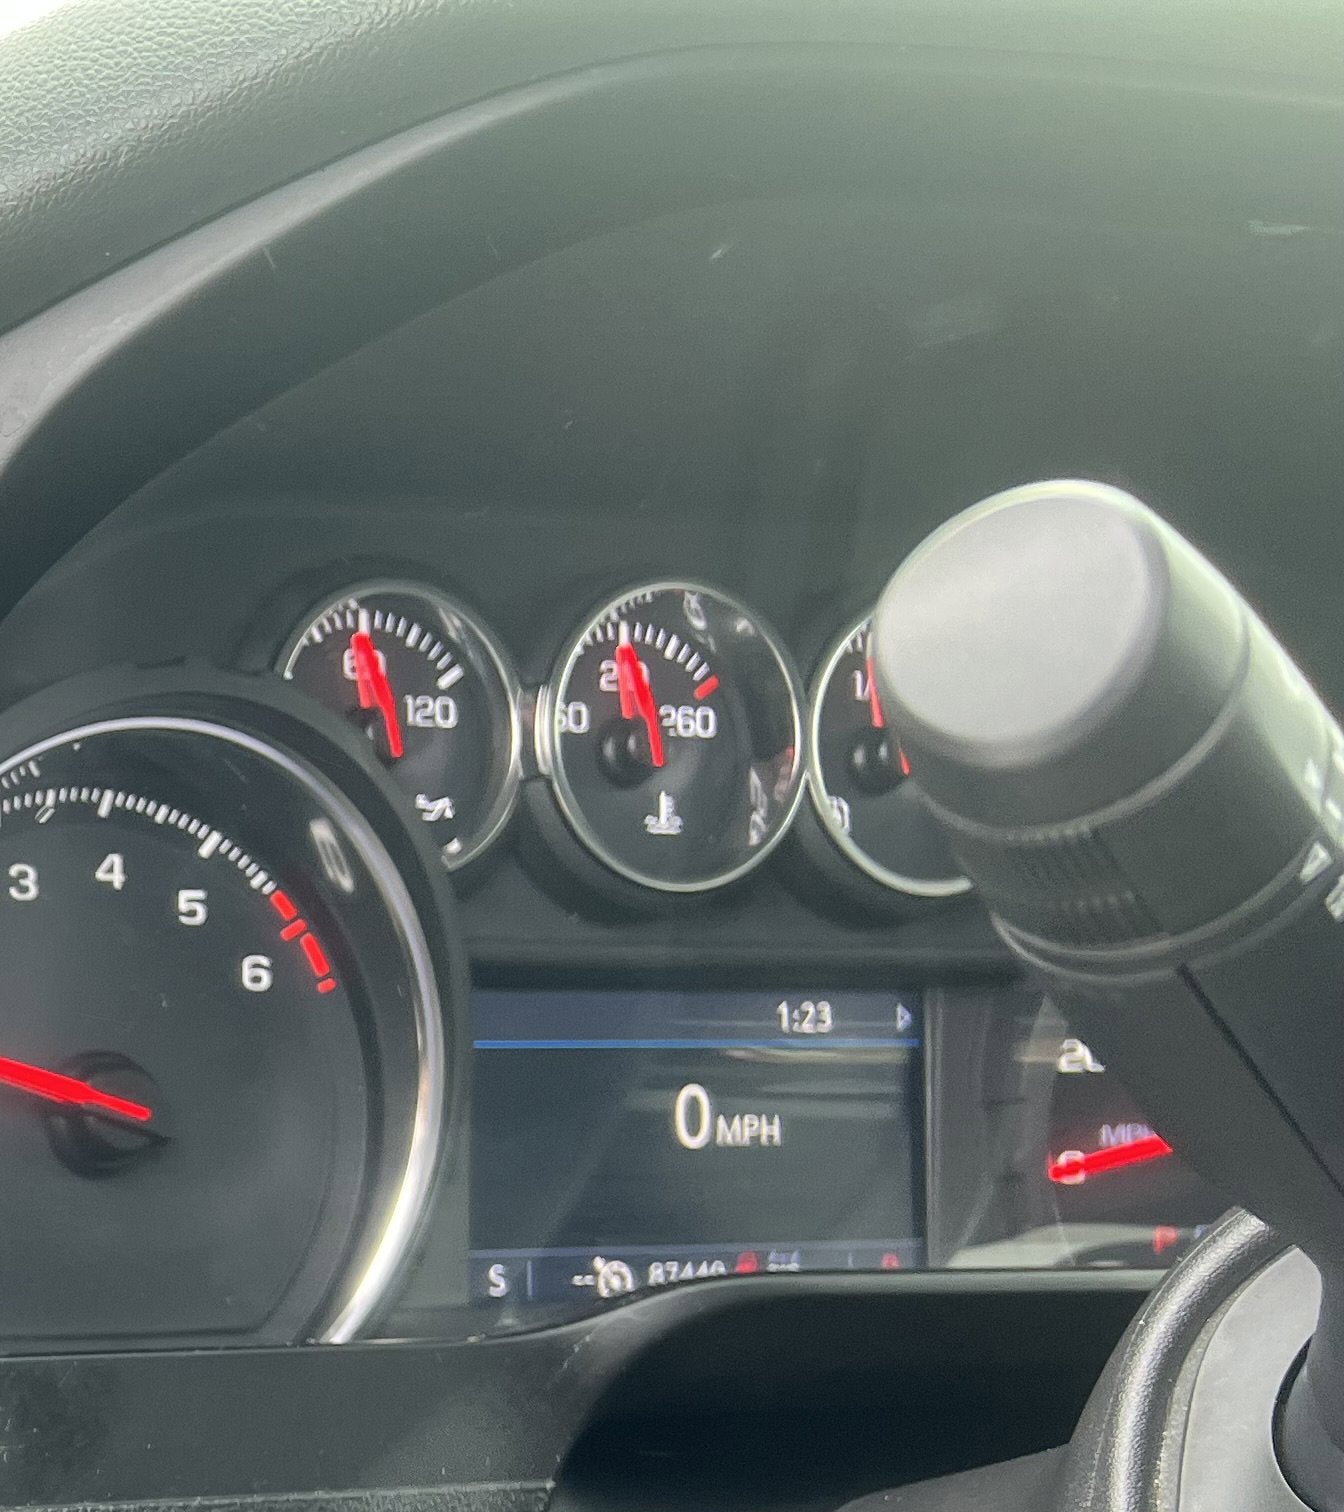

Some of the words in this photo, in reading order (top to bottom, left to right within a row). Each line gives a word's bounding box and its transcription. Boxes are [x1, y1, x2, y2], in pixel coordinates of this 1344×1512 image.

[403, 694, 459, 728] 120
[659, 704, 718, 739] 260
[9, 863, 39, 901] 3
[95, 853, 126, 890] 4
[177, 889, 208, 926] 5
[242, 954, 273, 992] 6
[776, 1000, 833, 1034] 1:23
[675, 1083, 713, 1150] 0
[715, 1114, 783, 1147] MPH
